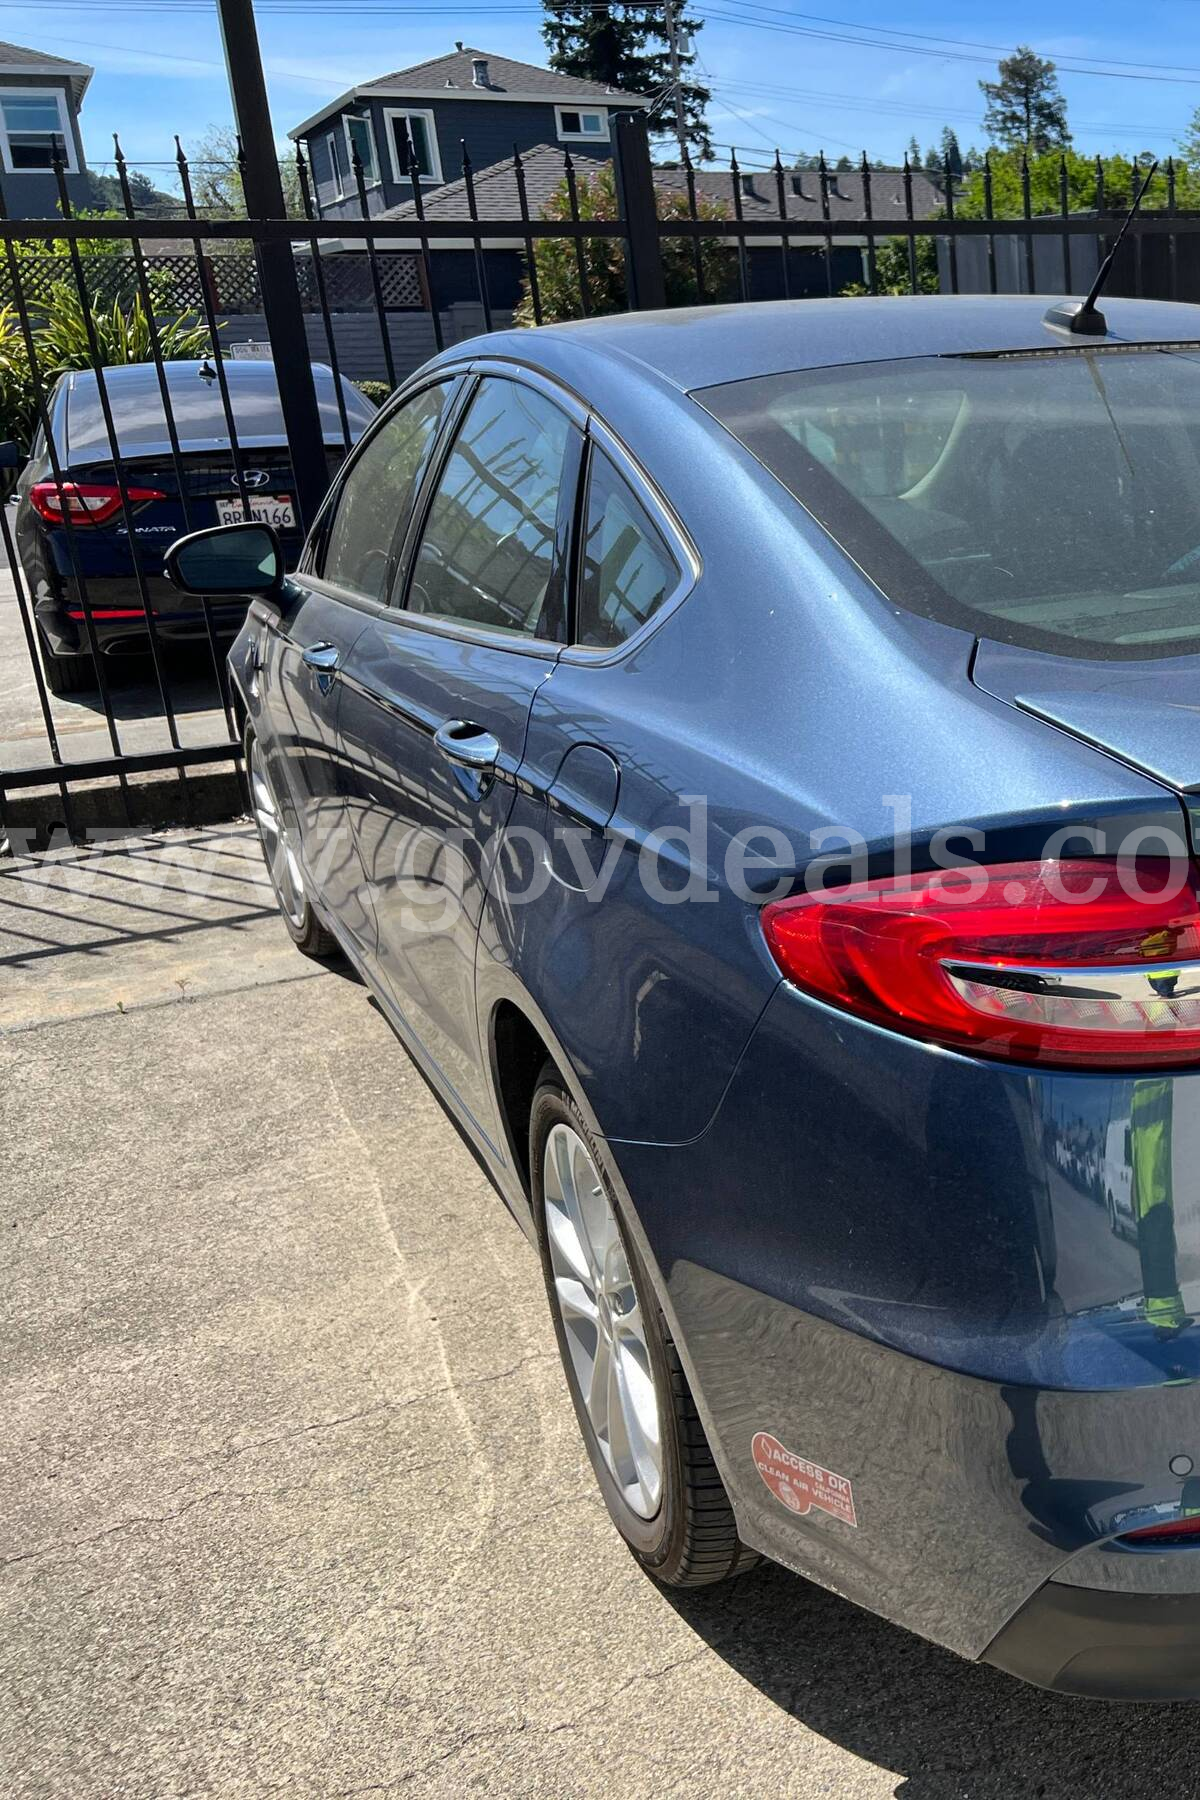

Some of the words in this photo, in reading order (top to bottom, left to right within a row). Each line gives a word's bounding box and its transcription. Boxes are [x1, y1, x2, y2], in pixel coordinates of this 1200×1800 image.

[222, 507, 292, 526] 8RN166
[758, 1461, 790, 1483] CLEAN
[793, 1478, 809, 1492] AIR
[811, 1487, 852, 1515] VEHICLE
[773, 1448, 824, 1482] ACCESS
[828, 1474, 849, 1495] OK
